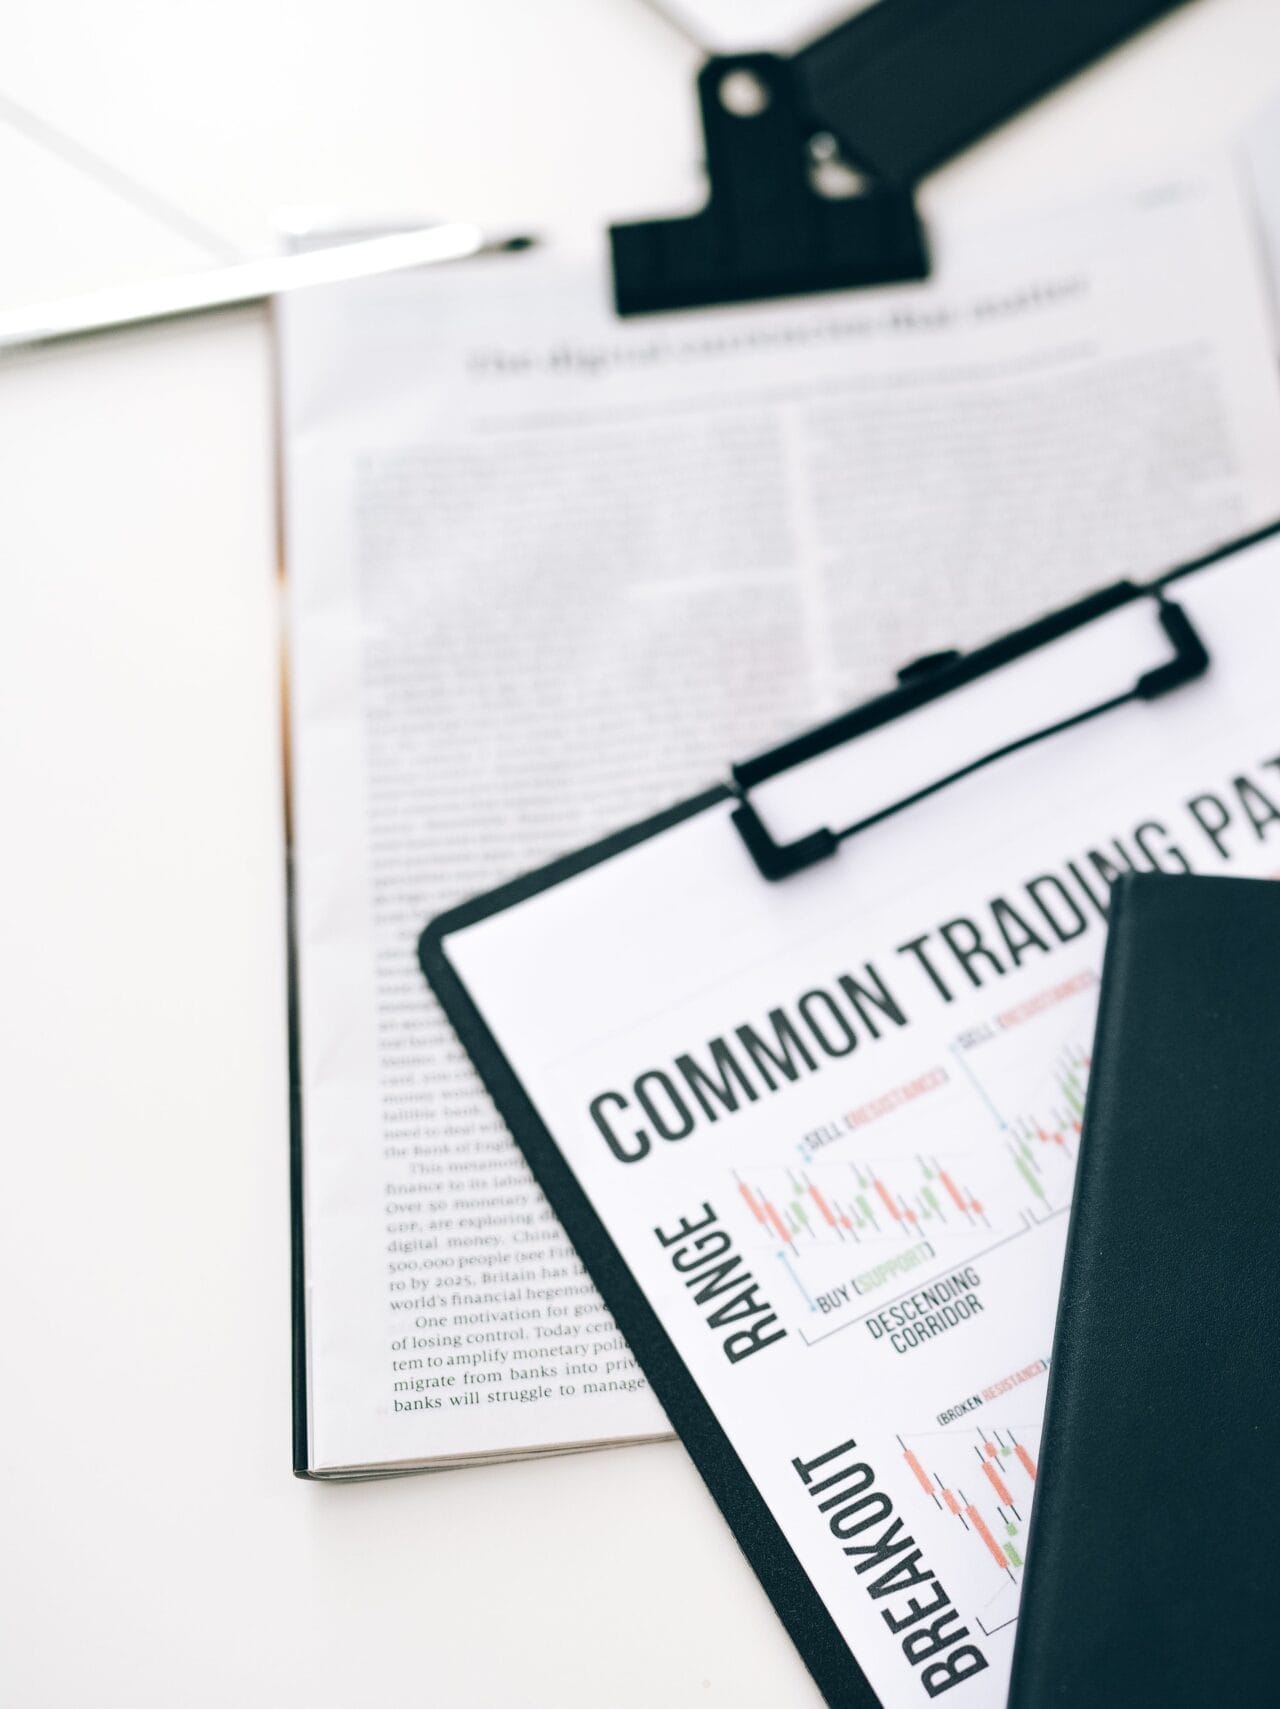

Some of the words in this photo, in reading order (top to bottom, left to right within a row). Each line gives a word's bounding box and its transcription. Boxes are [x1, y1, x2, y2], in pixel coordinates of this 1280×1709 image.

[587, 967, 909, 1164] COMMON
[896, 820, 1193, 1005] TRADING
[459, 1212, 534, 1228] exploring
[387, 1236, 439, 1253] digital
[514, 1229, 560, 1242] China
[458, 1252, 512, 1268] people
[516, 1249, 543, 1262] (see
[389, 1281, 406, 1292] ro
[411, 1277, 430, 1291] by
[482, 1268, 536, 1284] Britain
[542, 1265, 568, 1278] has
[653, 1202, 788, 1364] RANGE
[389, 1294, 448, 1311] world's
[451, 1287, 522, 1306] financial
[816, 1286, 853, 1314] BUY
[864, 1266, 982, 1340] DESCENDING
[415, 1315, 448, 1329] One
[453, 1308, 541, 1326] motivation
[546, 1305, 569, 1318] for
[889, 1293, 985, 1354] CORRIDOR
[391, 1337, 408, 1351] of
[412, 1333, 462, 1349] losing
[466, 1328, 529, 1345] control.
[535, 1323, 582, 1340] Today
[392, 1358, 423, 1372] tem
[427, 1356, 443, 1368] to
[447, 1349, 509, 1368] amplify
[512, 1344, 589, 1361] monetary
[393, 1374, 456, 1393] migrate
[463, 1371, 503, 1385] from
[510, 1364, 558, 1381] banks
[565, 1362, 598, 1376] into
[394, 1396, 442, 1413] banks
[450, 1391, 480, 1408] will
[487, 1385, 553, 1404] struggle
[560, 1384, 576, 1397] to
[583, 1376, 647, 1395] manage
[791, 1439, 990, 1698] BREAKOUT
